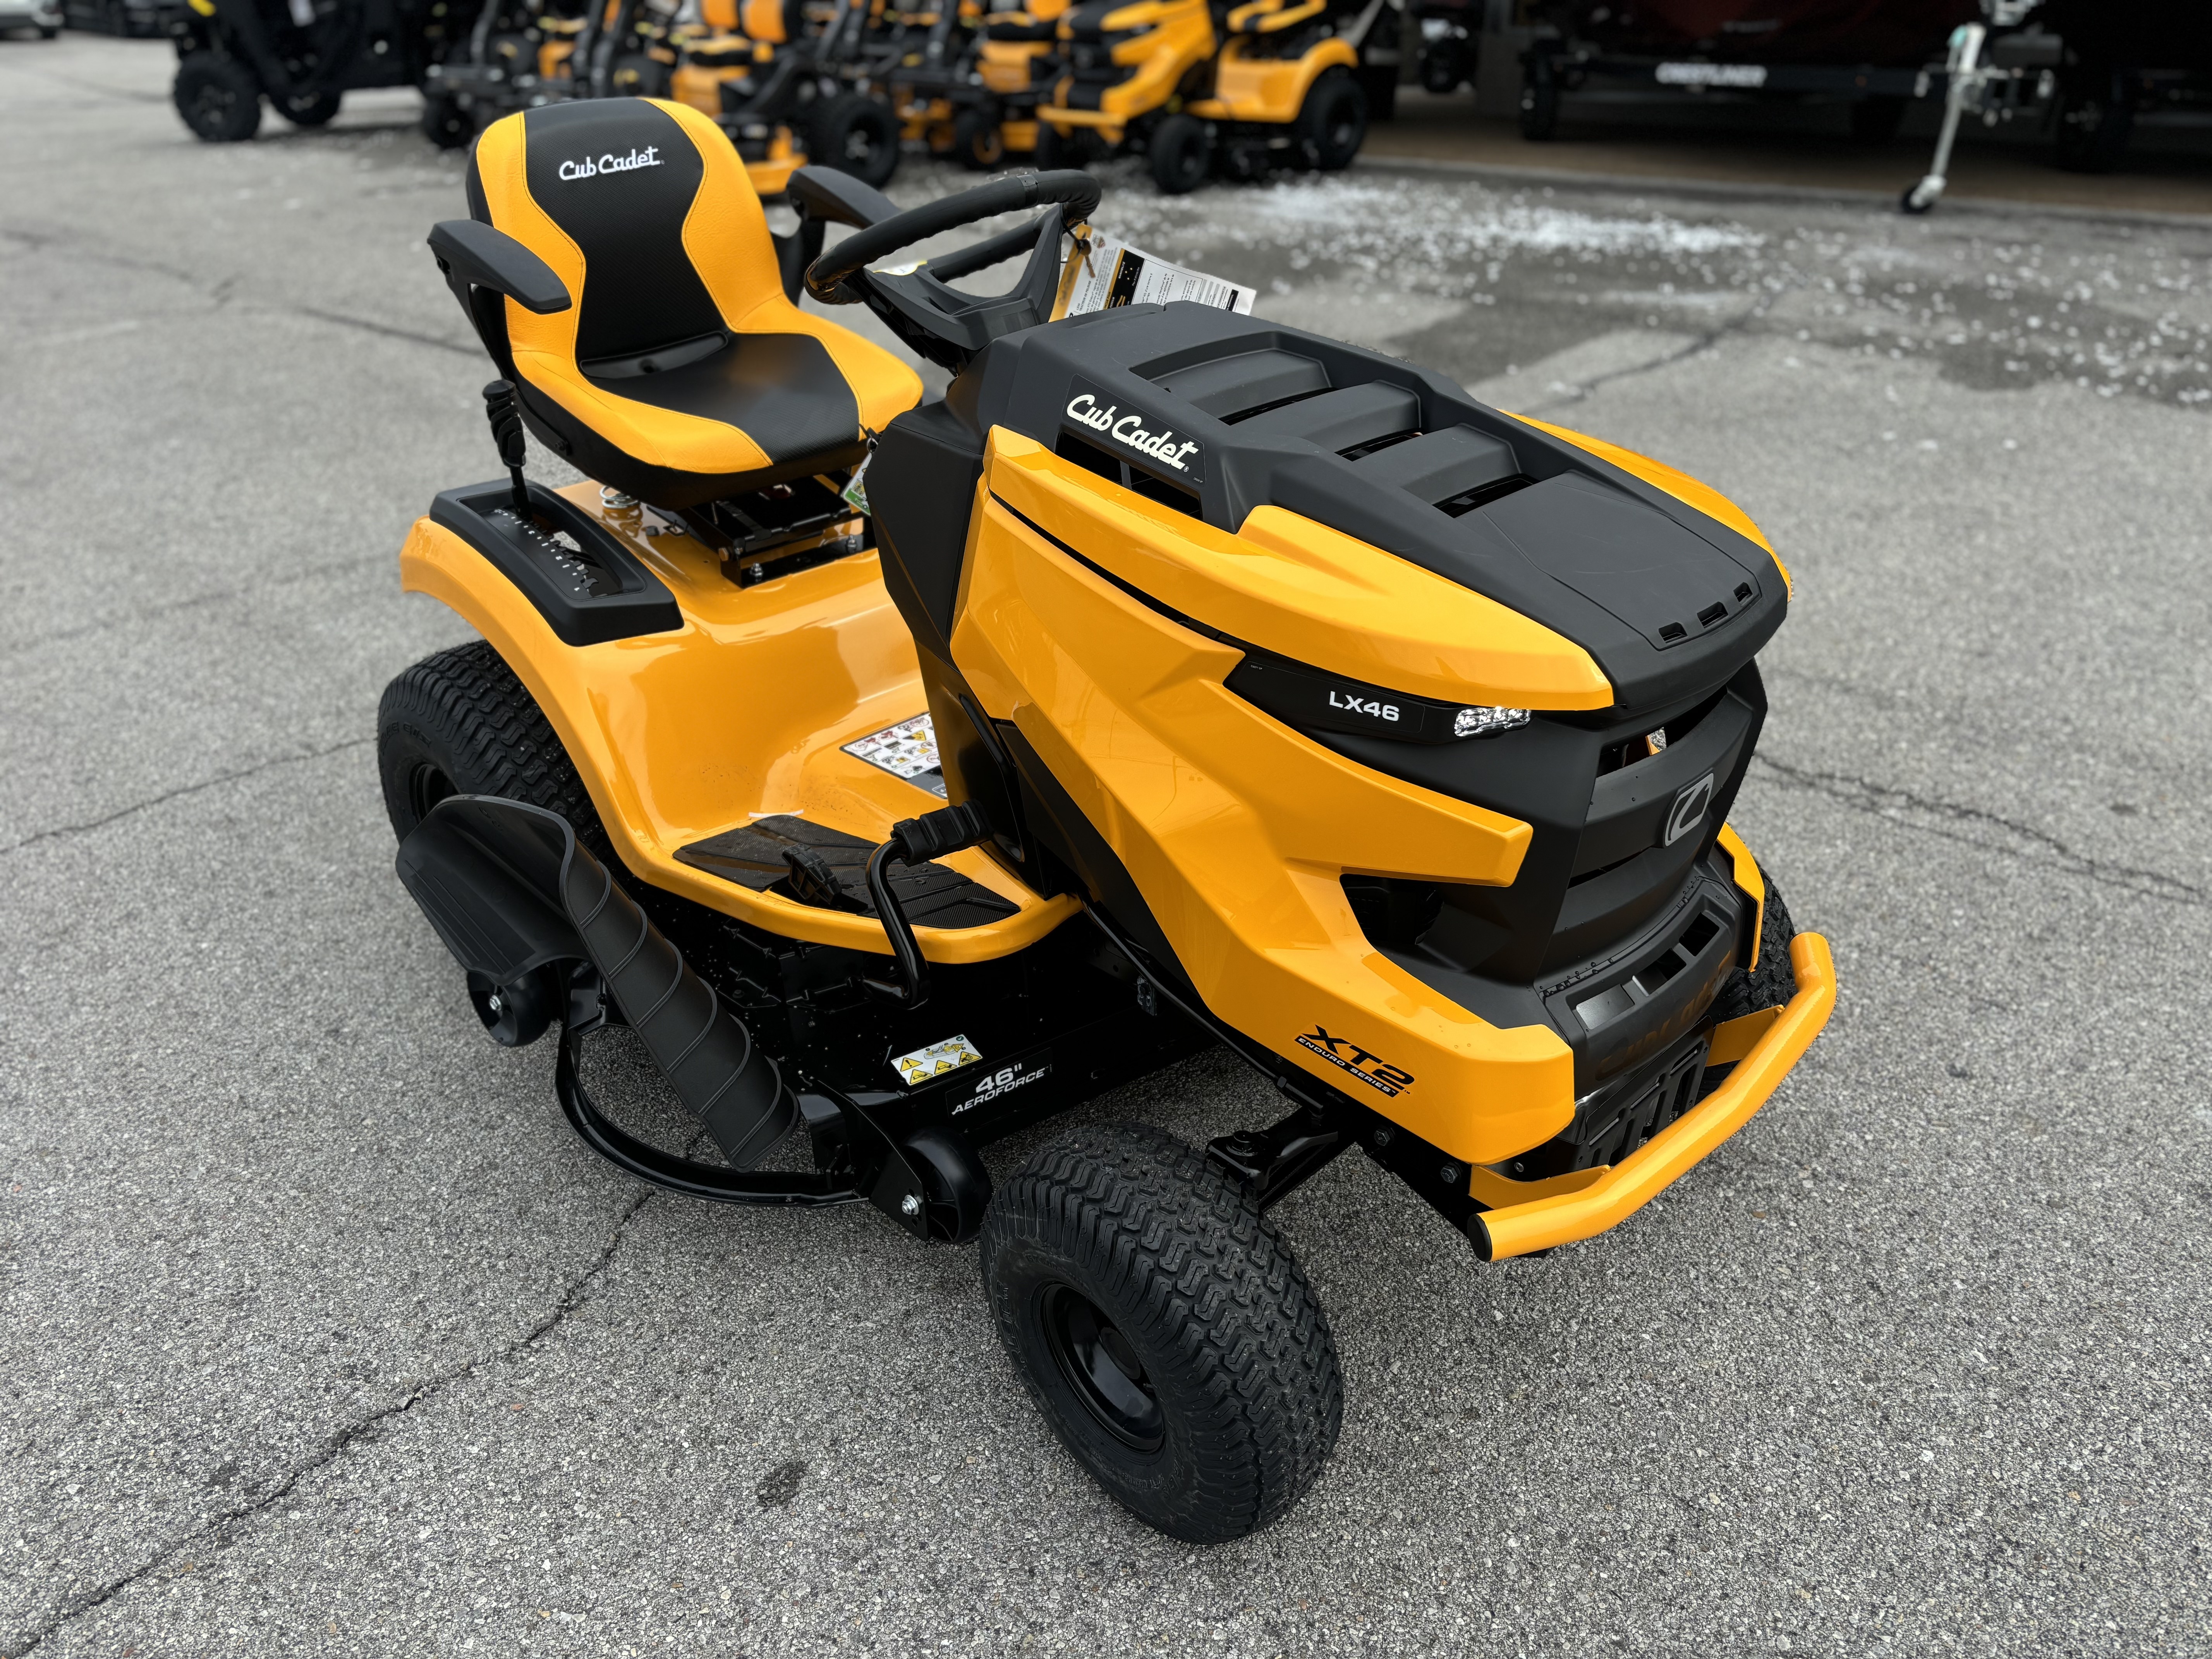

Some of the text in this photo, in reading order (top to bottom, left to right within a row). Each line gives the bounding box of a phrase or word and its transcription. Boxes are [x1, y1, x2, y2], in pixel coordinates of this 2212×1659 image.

[559, 156, 596, 180] Cub
[1066, 394, 1117, 431] Cub
[1329, 691, 1400, 722] LX46
[1298, 1037, 1346, 1066] ENDURO
